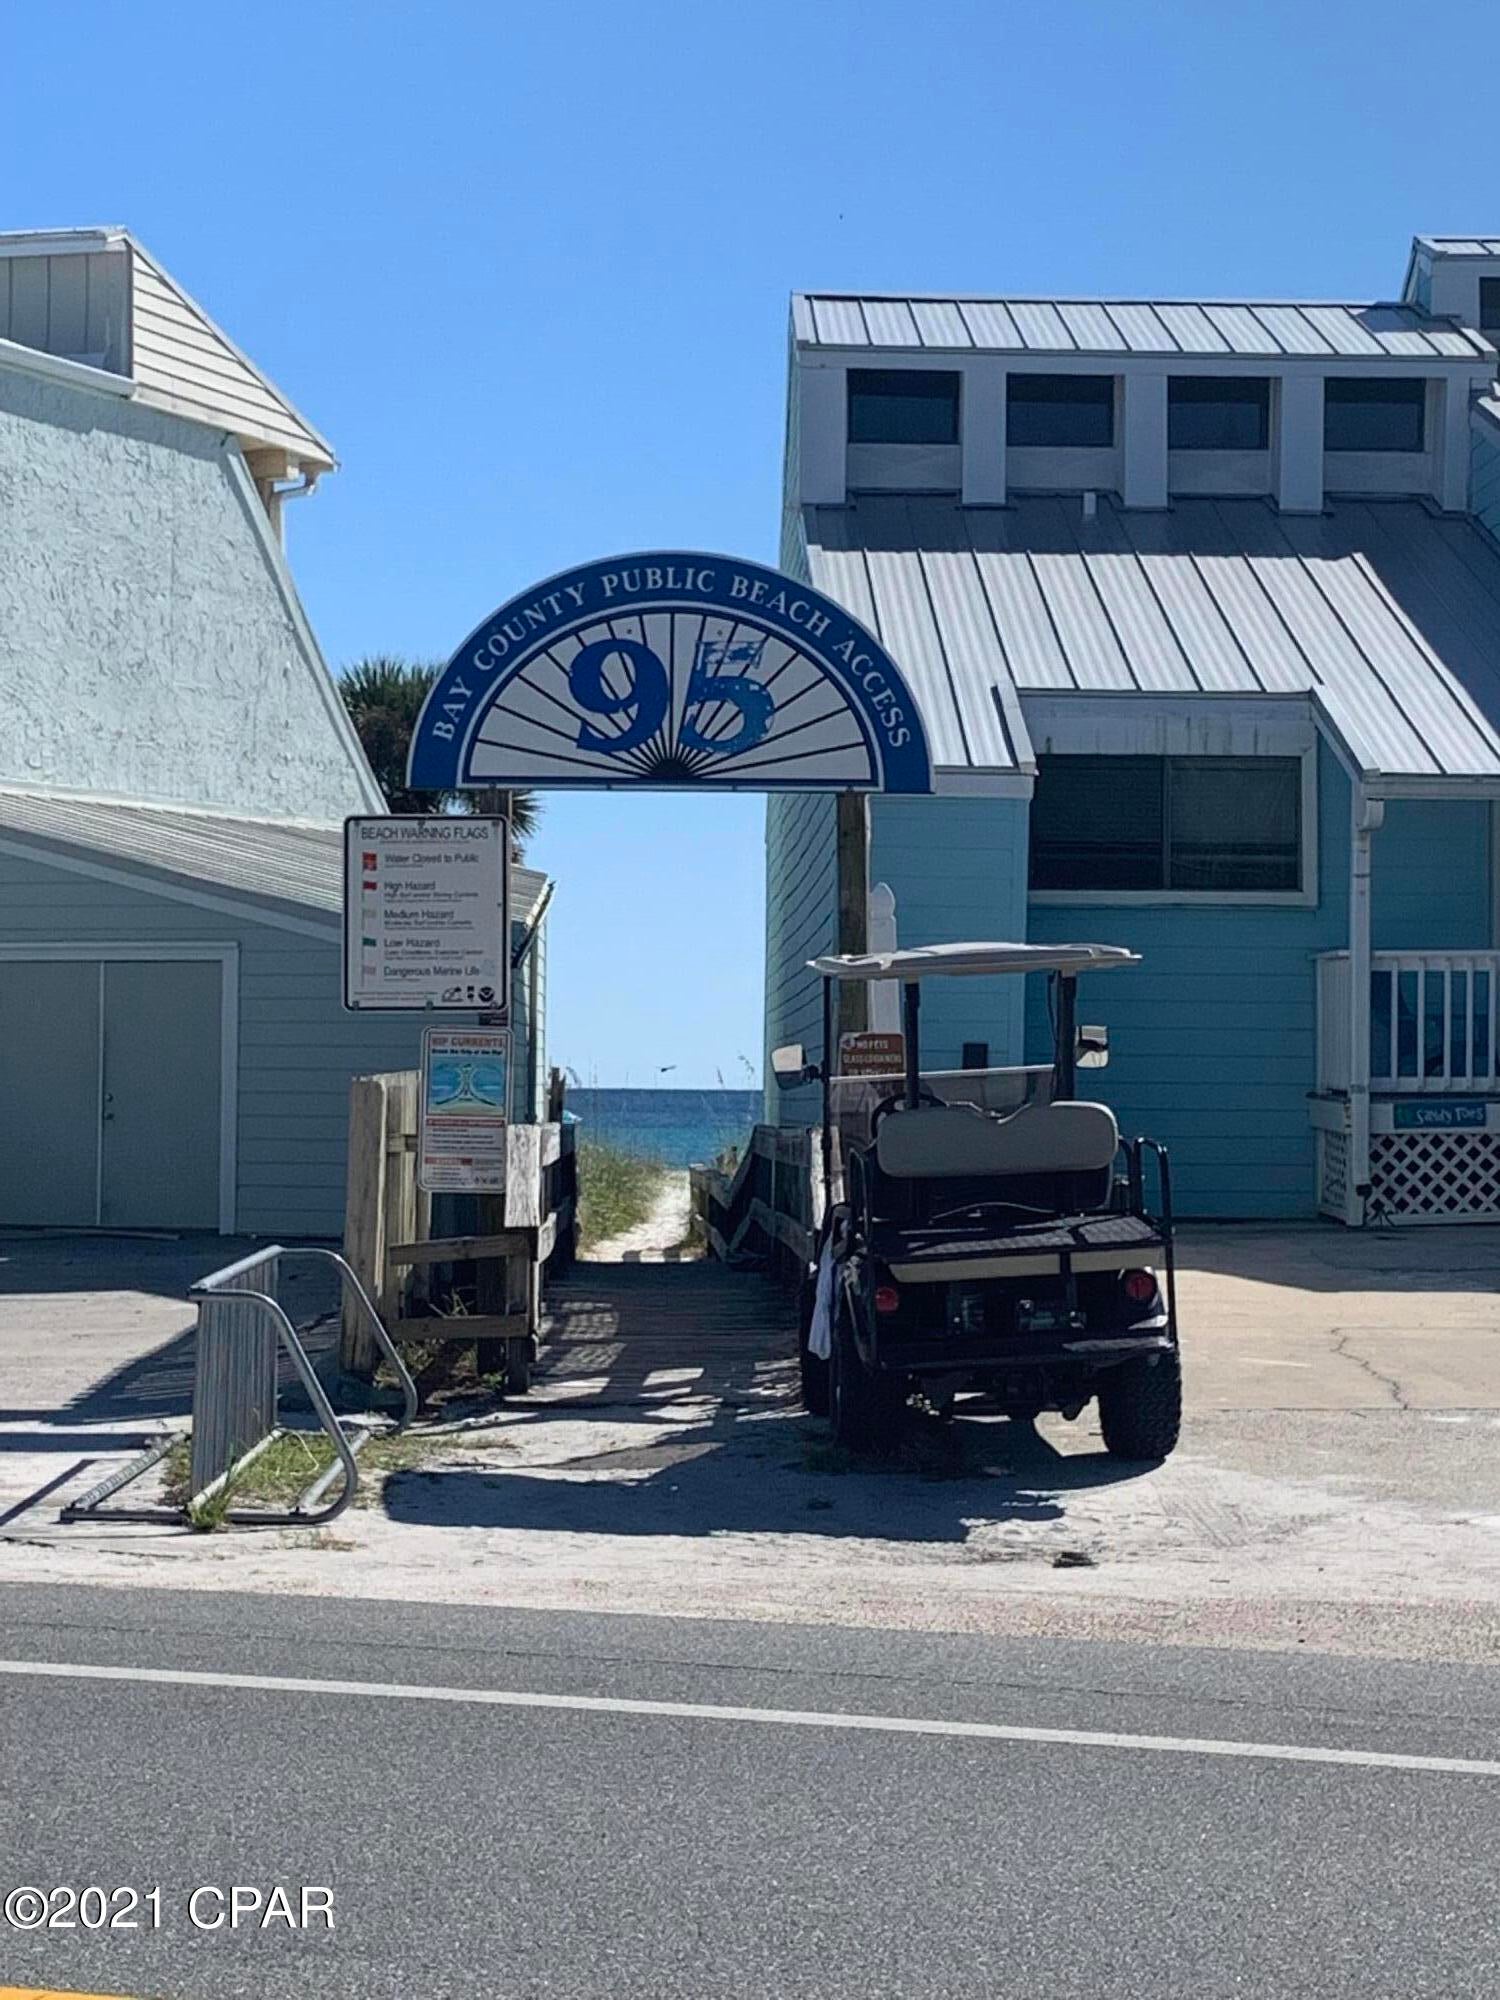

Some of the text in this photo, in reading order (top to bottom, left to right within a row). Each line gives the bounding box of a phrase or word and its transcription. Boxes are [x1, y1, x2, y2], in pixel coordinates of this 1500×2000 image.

[432, 566, 911, 749] BAY COUNTY PUBLIC BEACH ACCESS
[568, 638, 776, 754] 95
[361, 827, 488, 840] BEACH WARNING FLAGS
[385, 854, 409, 863] Water
[444, 854, 453, 863] to
[384, 881, 436, 893] High Hazard
[384, 909, 454, 919] Medium Hazard
[384, 938, 440, 947] Low Hazard
[384, 966, 431, 978] Dangerous
